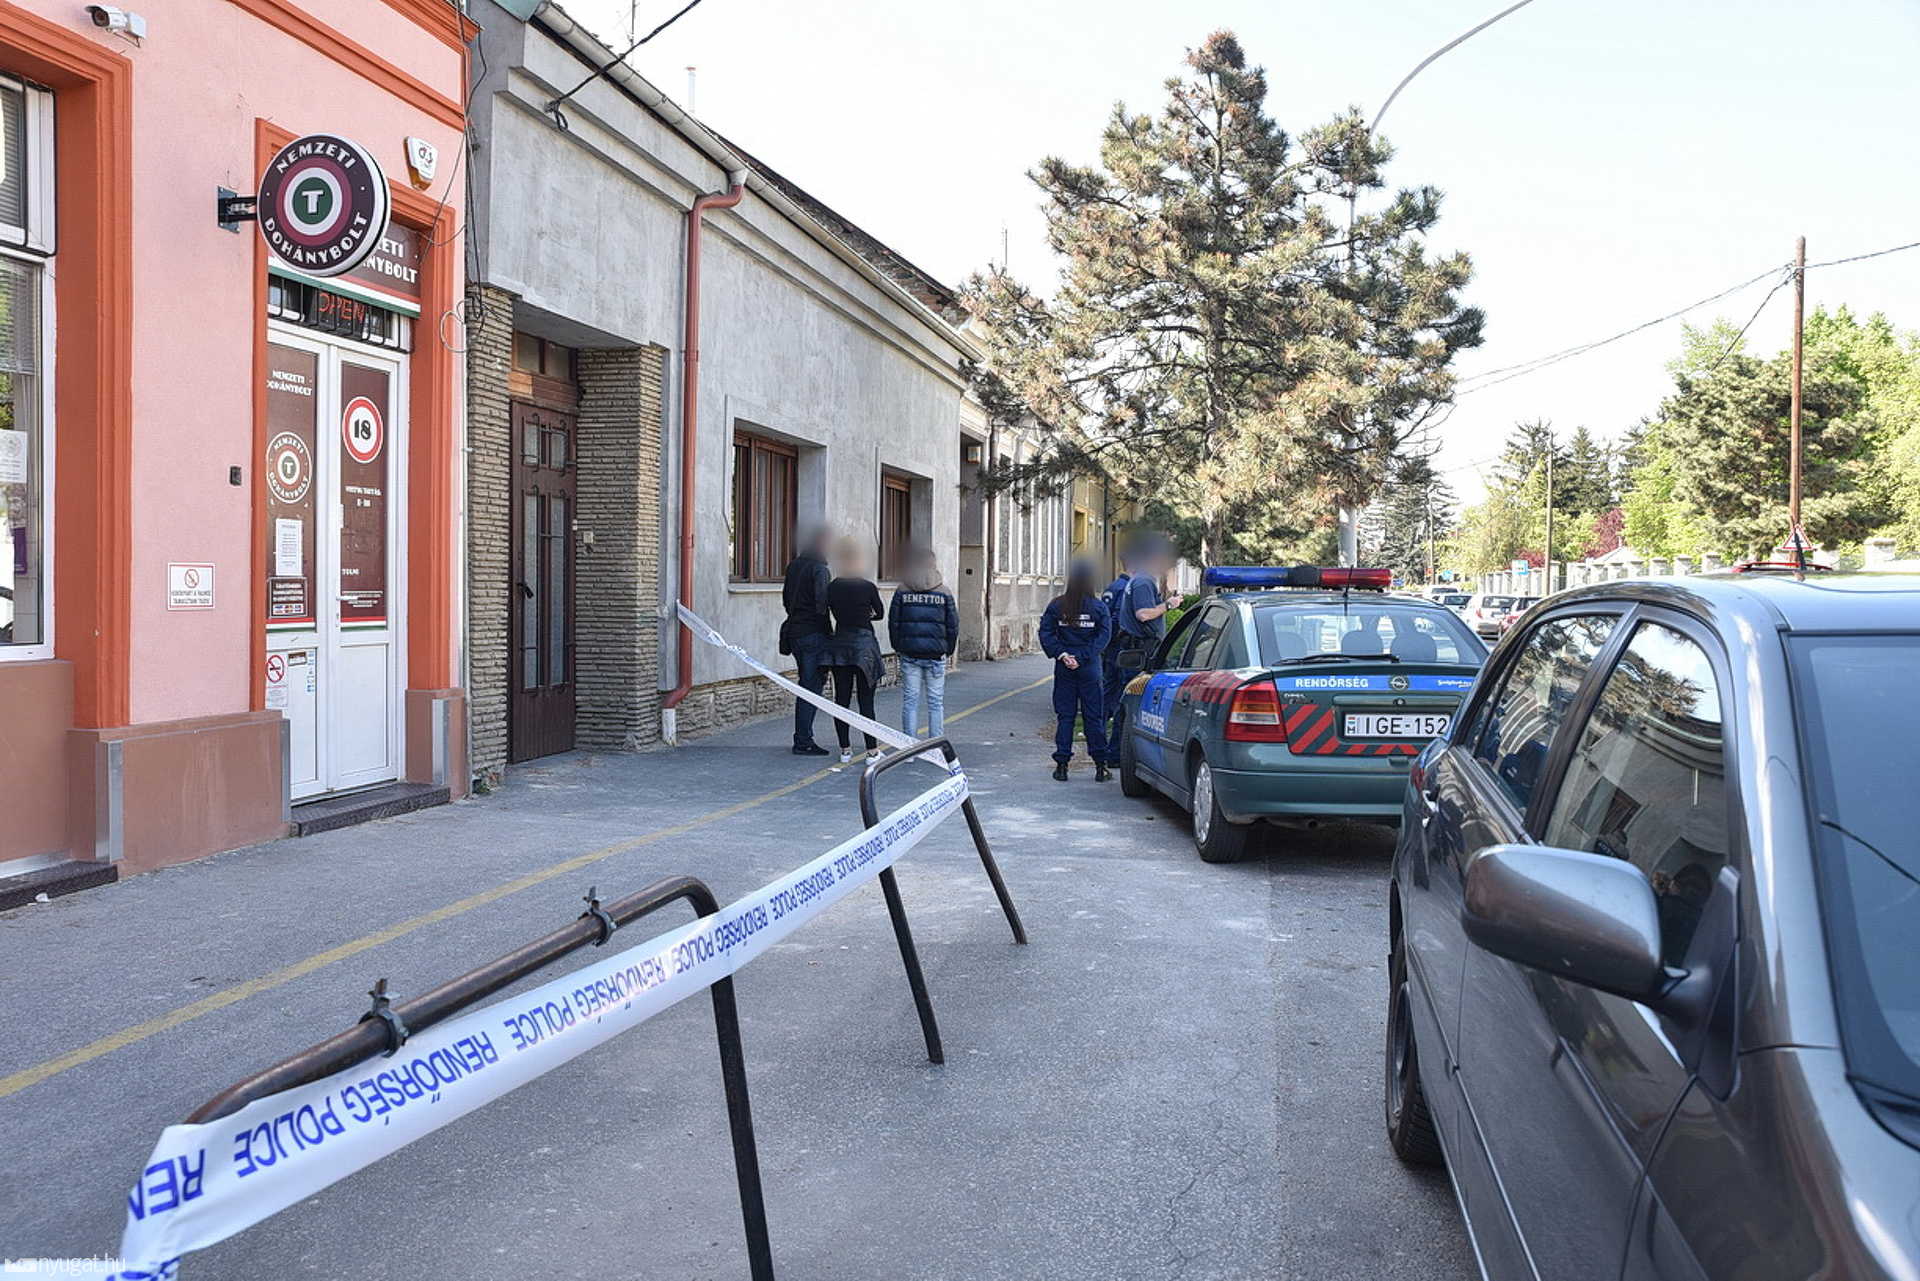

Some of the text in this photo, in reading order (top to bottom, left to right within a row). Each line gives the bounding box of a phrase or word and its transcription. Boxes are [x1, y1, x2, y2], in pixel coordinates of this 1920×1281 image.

[276, 142, 356, 173] NEMZETI
[302, 189, 324, 214] T
[264, 212, 367, 264] DOHÁNYBOLT
[318, 292, 366, 322] OPEN
[272, 370, 305, 384] NEMZETI
[353, 418, 372, 440] 18
[283, 461, 294, 475] T
[1295, 677, 1369, 688] RENDŐRSÉG
[1365, 717, 1448, 735] IGE-152
[769, 886, 799, 921] POLICE
[715, 903, 769, 956] RENDŐRSÉG
[670, 935, 715, 974] POLICE
[573, 956, 667, 1024] RENDŐRSÉG
[504, 999, 577, 1051] POLICE
[340, 1030, 499, 1126] RENDŐRSÉG
[233, 1094, 346, 1179] POLICE
